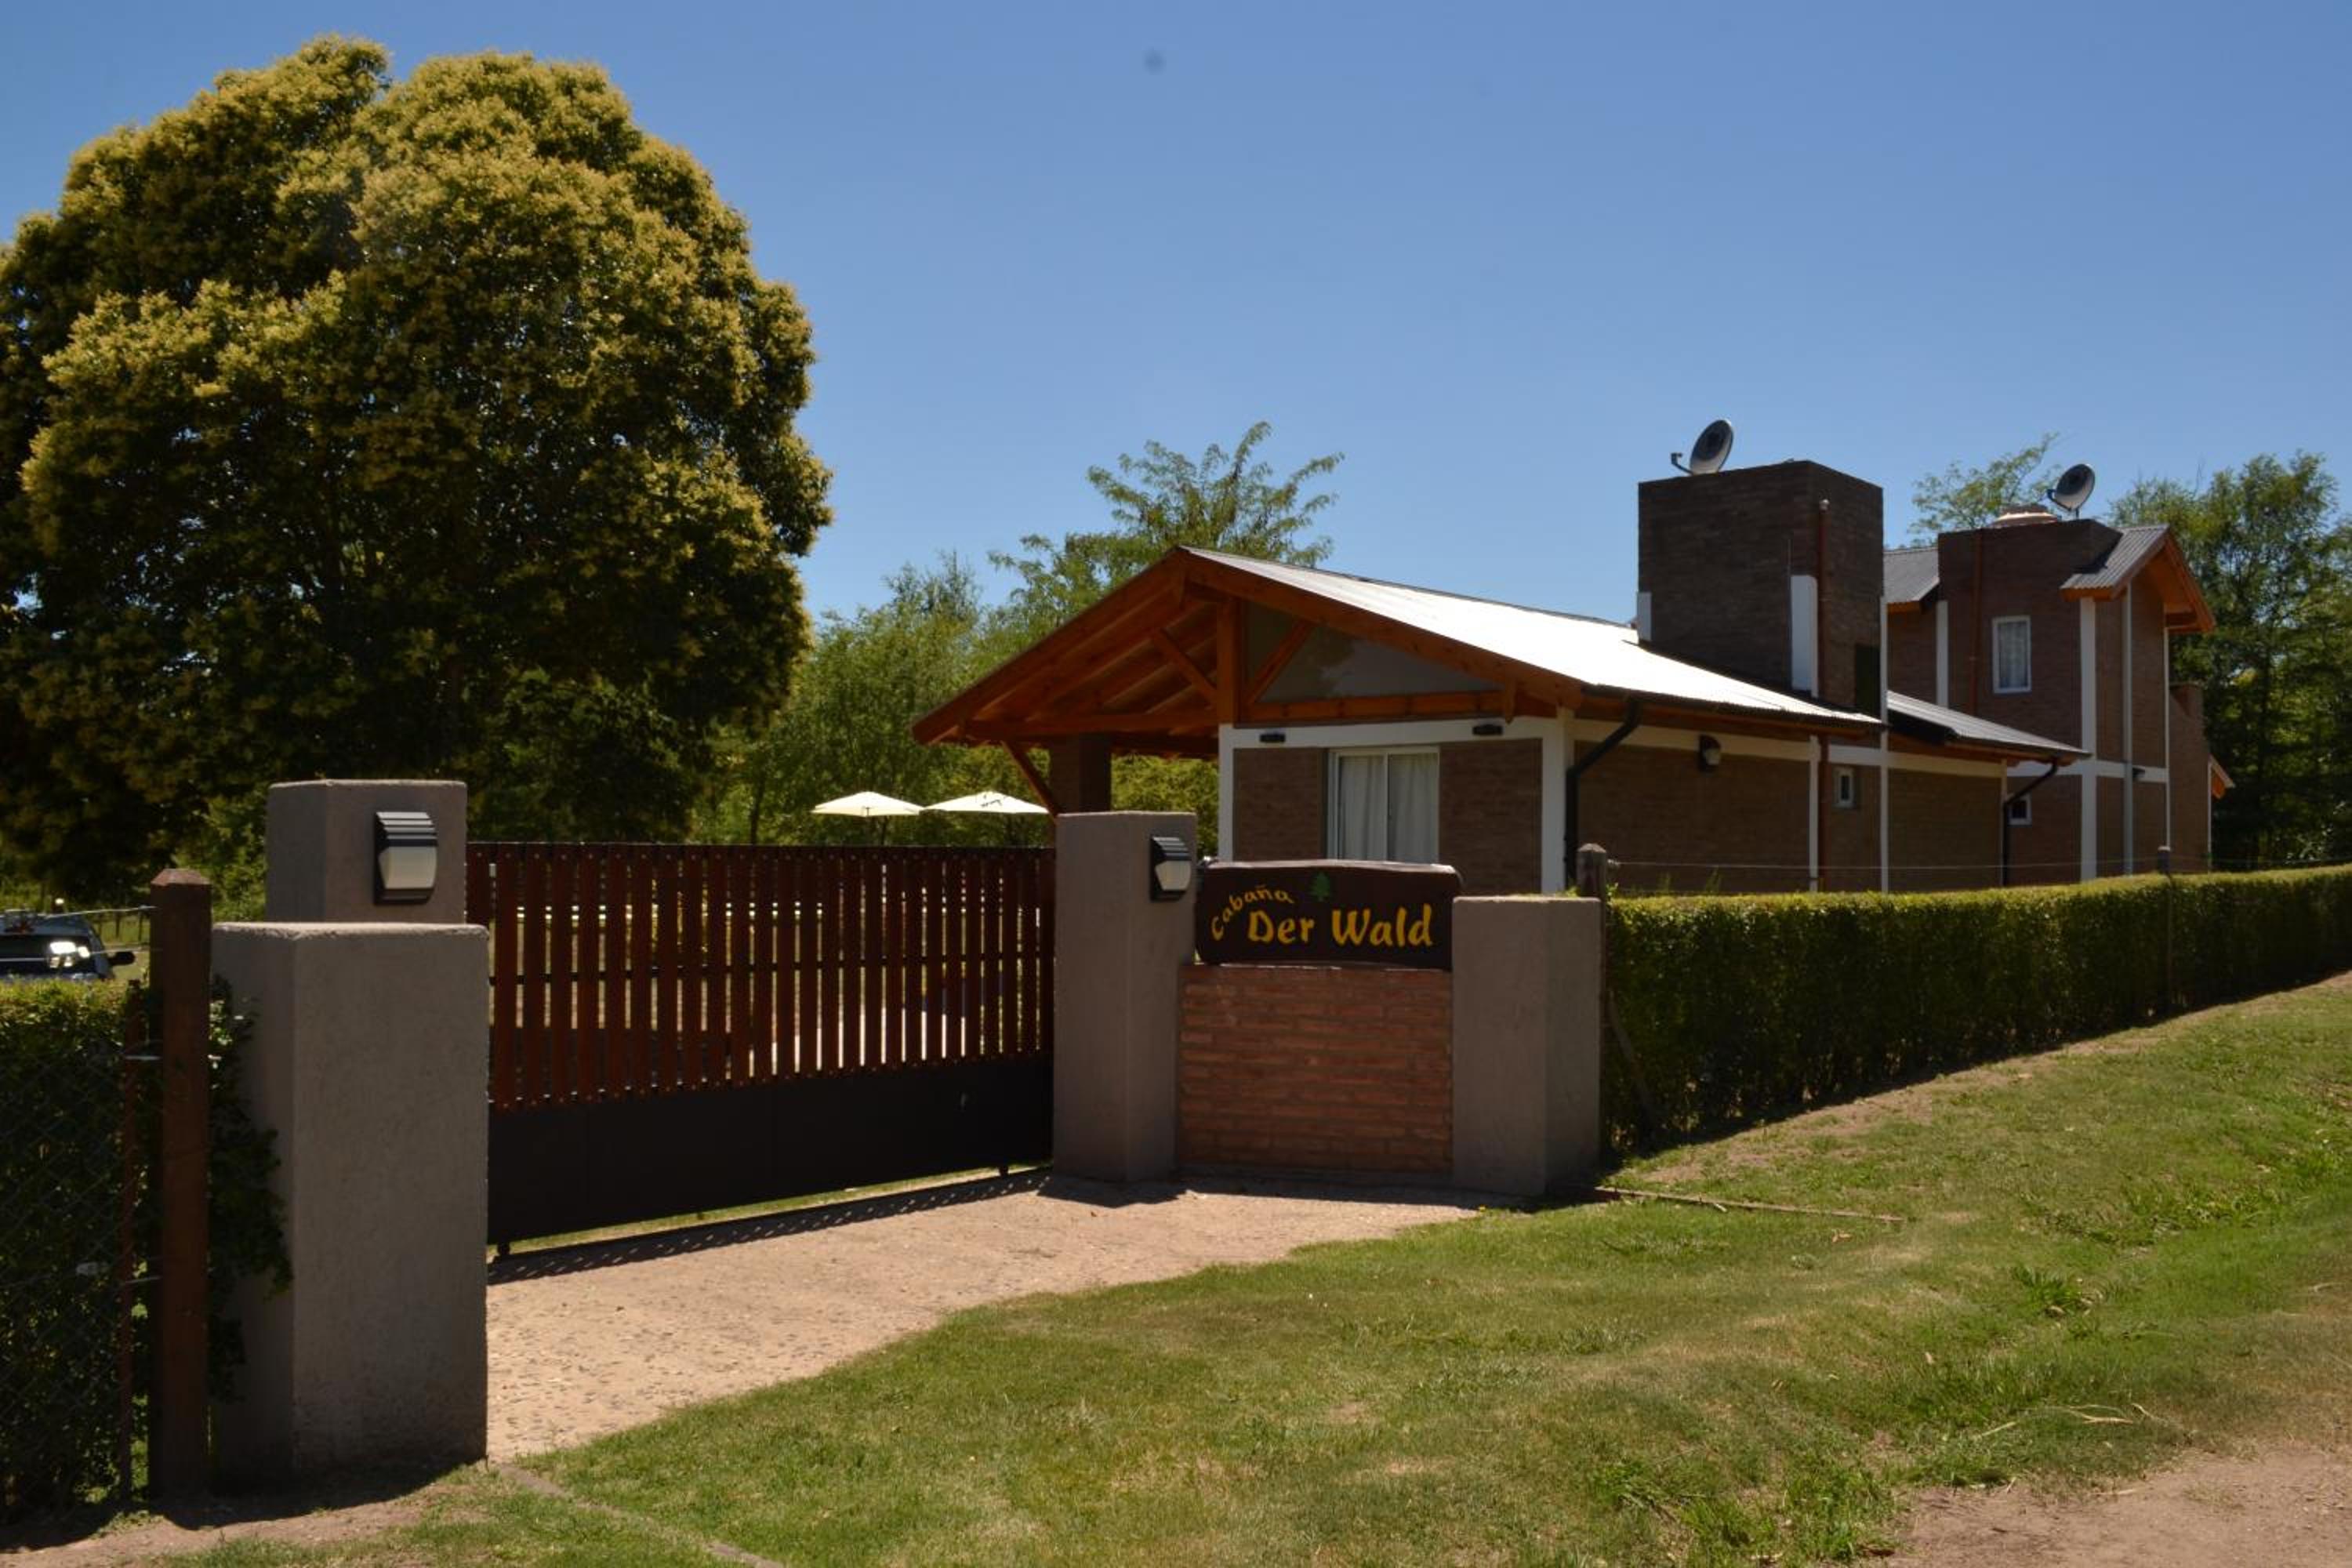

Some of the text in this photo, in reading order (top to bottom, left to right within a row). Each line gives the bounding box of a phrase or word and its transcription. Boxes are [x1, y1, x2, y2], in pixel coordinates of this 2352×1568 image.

[1211, 885, 1294, 941] Cabaña
[1248, 904, 1433, 946] Der Wald
